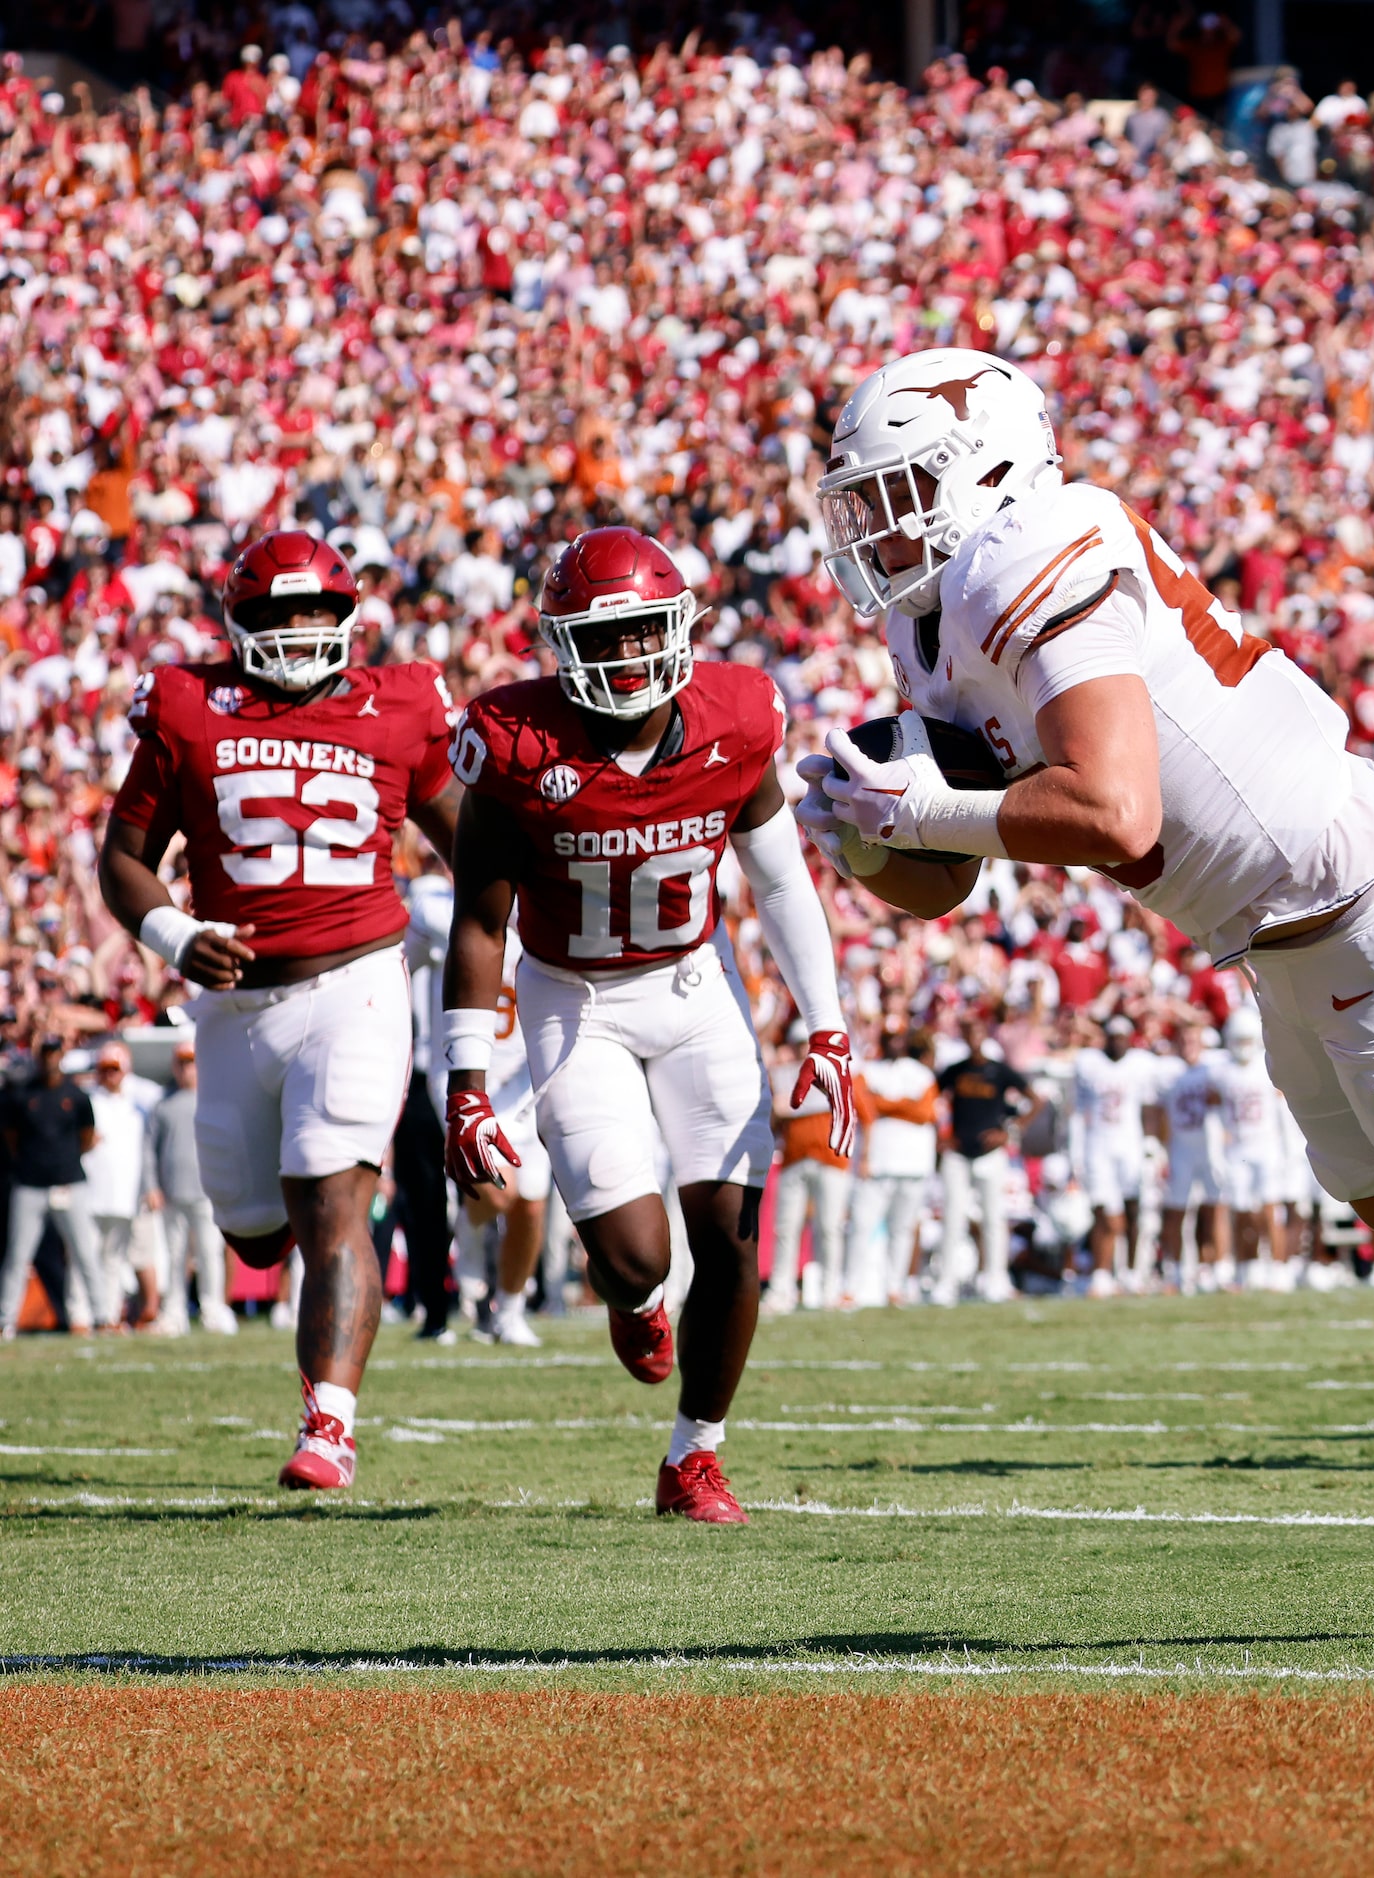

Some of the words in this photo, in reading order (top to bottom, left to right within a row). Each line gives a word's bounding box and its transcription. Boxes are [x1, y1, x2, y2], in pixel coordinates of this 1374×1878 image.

[215, 737, 375, 778] SOONERS
[543, 767, 578, 801] SEC
[213, 769, 380, 886] 52
[554, 810, 726, 857] SOONERS
[568, 845, 715, 959] 10
